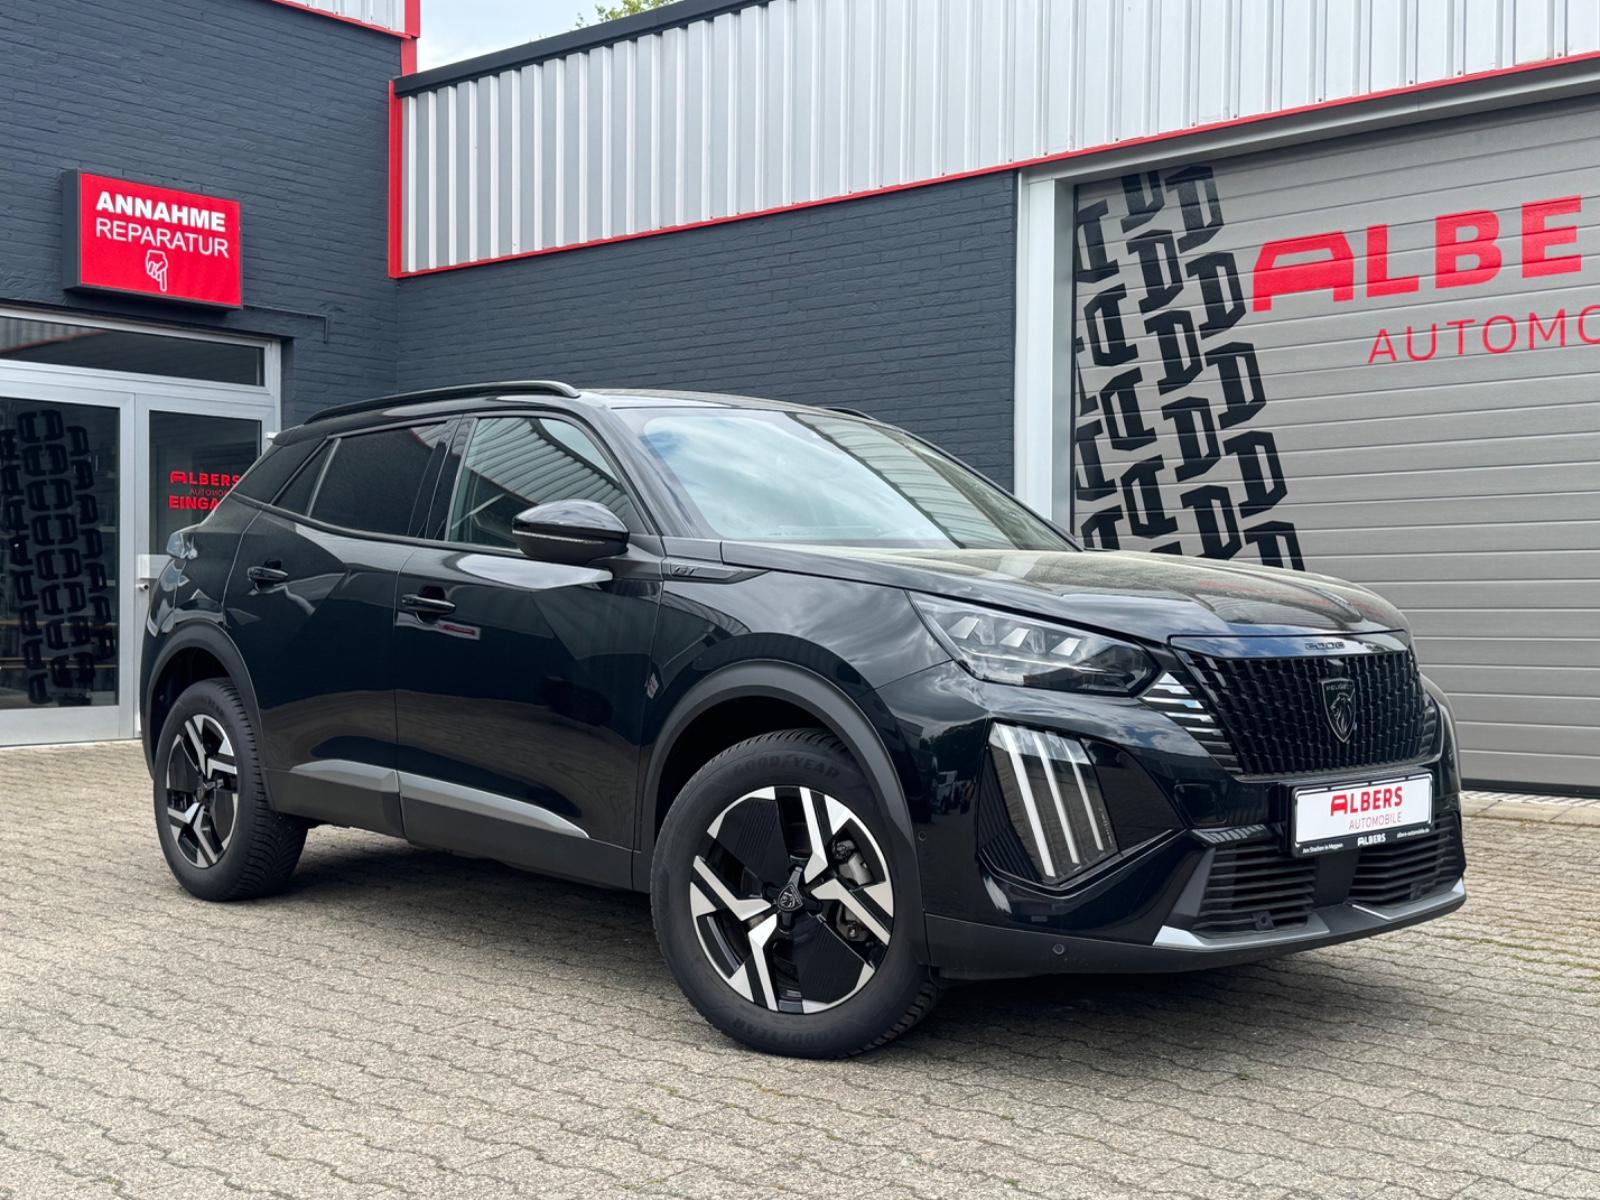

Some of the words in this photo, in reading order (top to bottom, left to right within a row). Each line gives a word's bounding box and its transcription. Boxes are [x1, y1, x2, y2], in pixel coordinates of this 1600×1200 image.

[96, 191, 226, 232] ANNAHME
[96, 217, 229, 258] REPARATUR
[1252, 194, 1582, 312] ALBE
[1330, 786, 1403, 816] ALBERS
[1348, 811, 1403, 831] AUTOMOBILE
[1357, 832, 1387, 847] ALBERS
